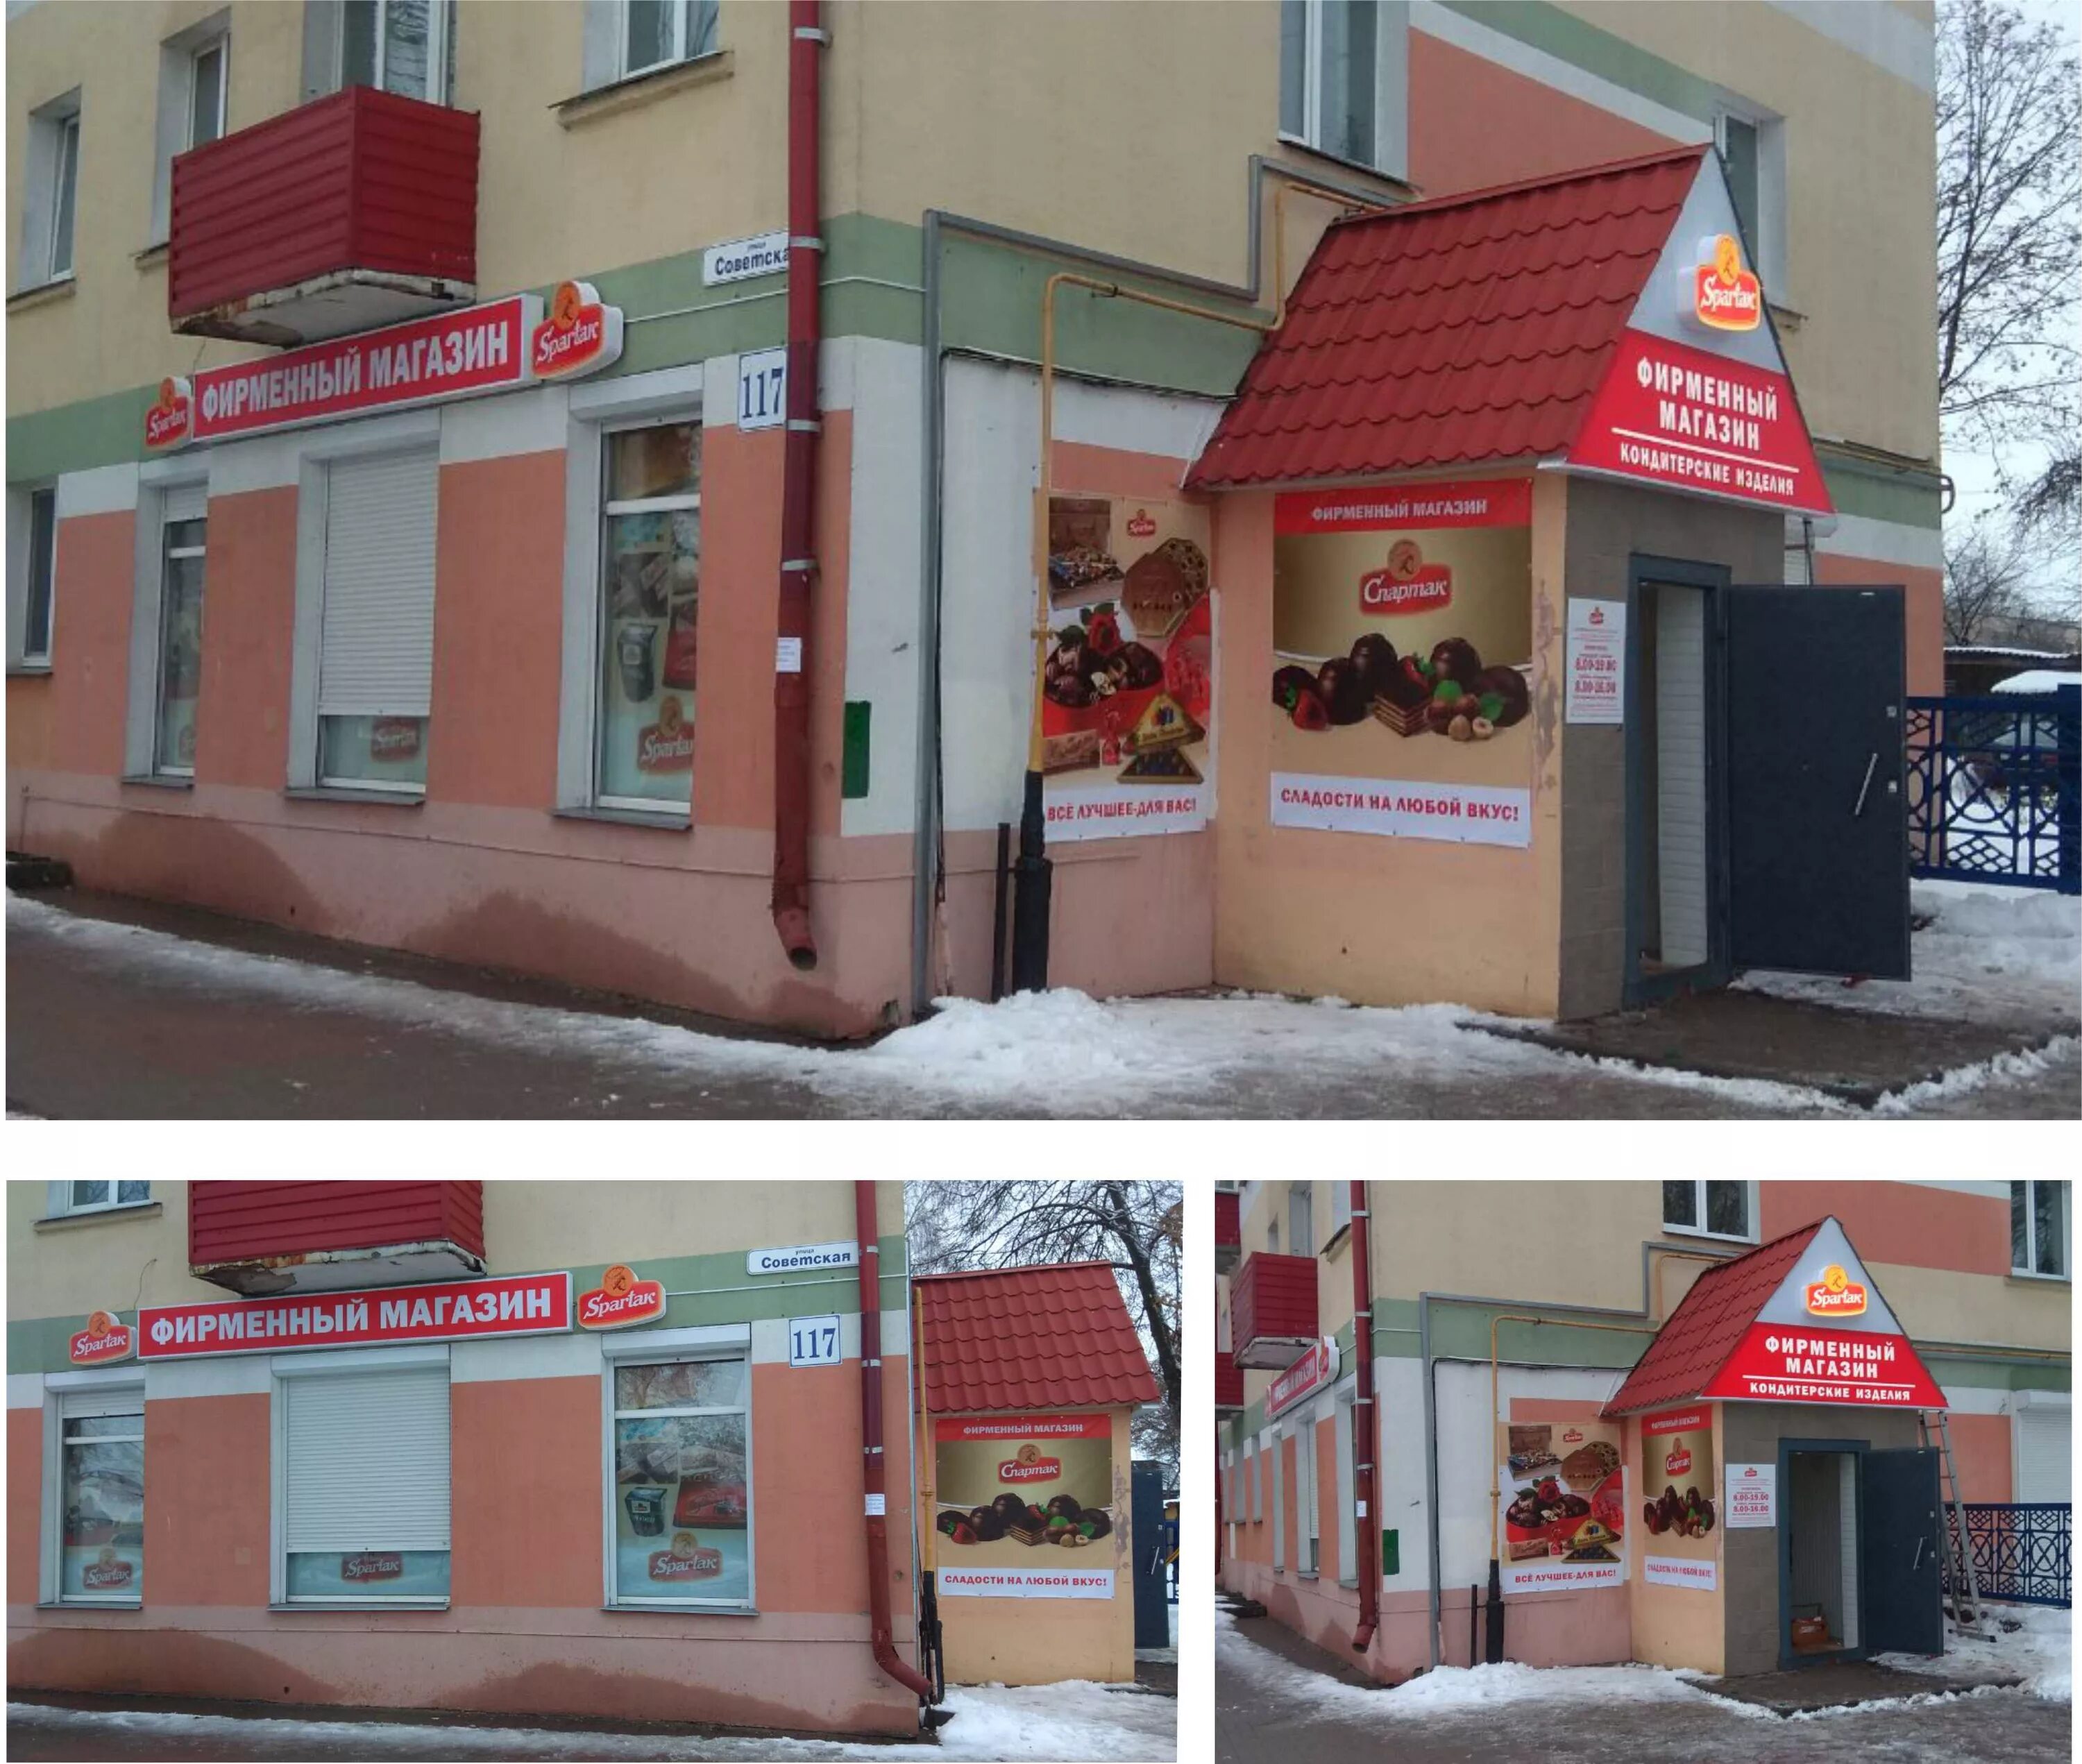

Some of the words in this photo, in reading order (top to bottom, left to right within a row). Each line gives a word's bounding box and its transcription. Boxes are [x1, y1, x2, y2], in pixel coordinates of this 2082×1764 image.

[715, 248, 790, 276] Советска
[1700, 275, 1757, 309] Spartak
[536, 318, 599, 363] Spartak
[202, 345, 362, 422] ФИРМЕННЫЙ
[369, 321, 508, 390] МАГАЗИН
[741, 367, 784, 418] 117
[1636, 355, 1778, 422] ФИРМЕННЫЙ
[1659, 400, 1761, 452] МАГАЗИН
[1620, 442, 1730, 484] КОНДИТЕРСКИЕ
[1736, 468, 1795, 496] ИЗДЕЛИЯ
[1312, 500, 1409, 520] ФИРМЕННЫЙ
[1413, 498, 1487, 516] МАГАЗИН
[1364, 575, 1447, 604] Спартак
[1047, 802, 1074, 822] ВСЁ
[1167, 797, 1197, 814] ВАС!
[1280, 787, 1364, 808] СЛАДОСТИ
[1368, 796, 1391, 811] НА
[1396, 798, 1461, 817] ЛЮБОЙ
[1467, 802, 1518, 822] ВКУС!
[761, 1252, 851, 1269] Советская
[583, 1289, 656, 1320] Spartak
[1810, 1285, 1863, 1307] Spartak
[151, 1298, 369, 1346] ФИРМЕННЫЙ
[379, 1287, 551, 1330] МАГАЗИН
[73, 1333, 126, 1357] Spartak
[793, 1328, 836, 1359] 117
[1764, 1335, 1896, 1362] ФИРМЕННЫЙ
[1785, 1357, 1878, 1379] МАГАЗИН
[1750, 1382, 1851, 1399] КОНДИТЕРСКИЕ
[1855, 1387, 1911, 1401] ИЗДЕЛИЯ
[963, 1423, 1031, 1434] ФИРМЕННЫЙ
[1034, 1423, 1083, 1433] МАГАЗИН
[1001, 1461, 1058, 1478] Спартак
[85, 1567, 130, 1586] Spartak
[344, 1558, 400, 1577] Spartak
[653, 1554, 717, 1575] Spartak
[1514, 1572, 1533, 1584] ВСЁ
[1596, 1569, 1616, 1578] ВАС!
[945, 1575, 1004, 1585] СЛАДОСТИ
[1007, 1576, 1022, 1585] НА
[1025, 1575, 1069, 1586] ЛЮБОЙ
[1072, 1577, 1108, 1586] ВКУС!
